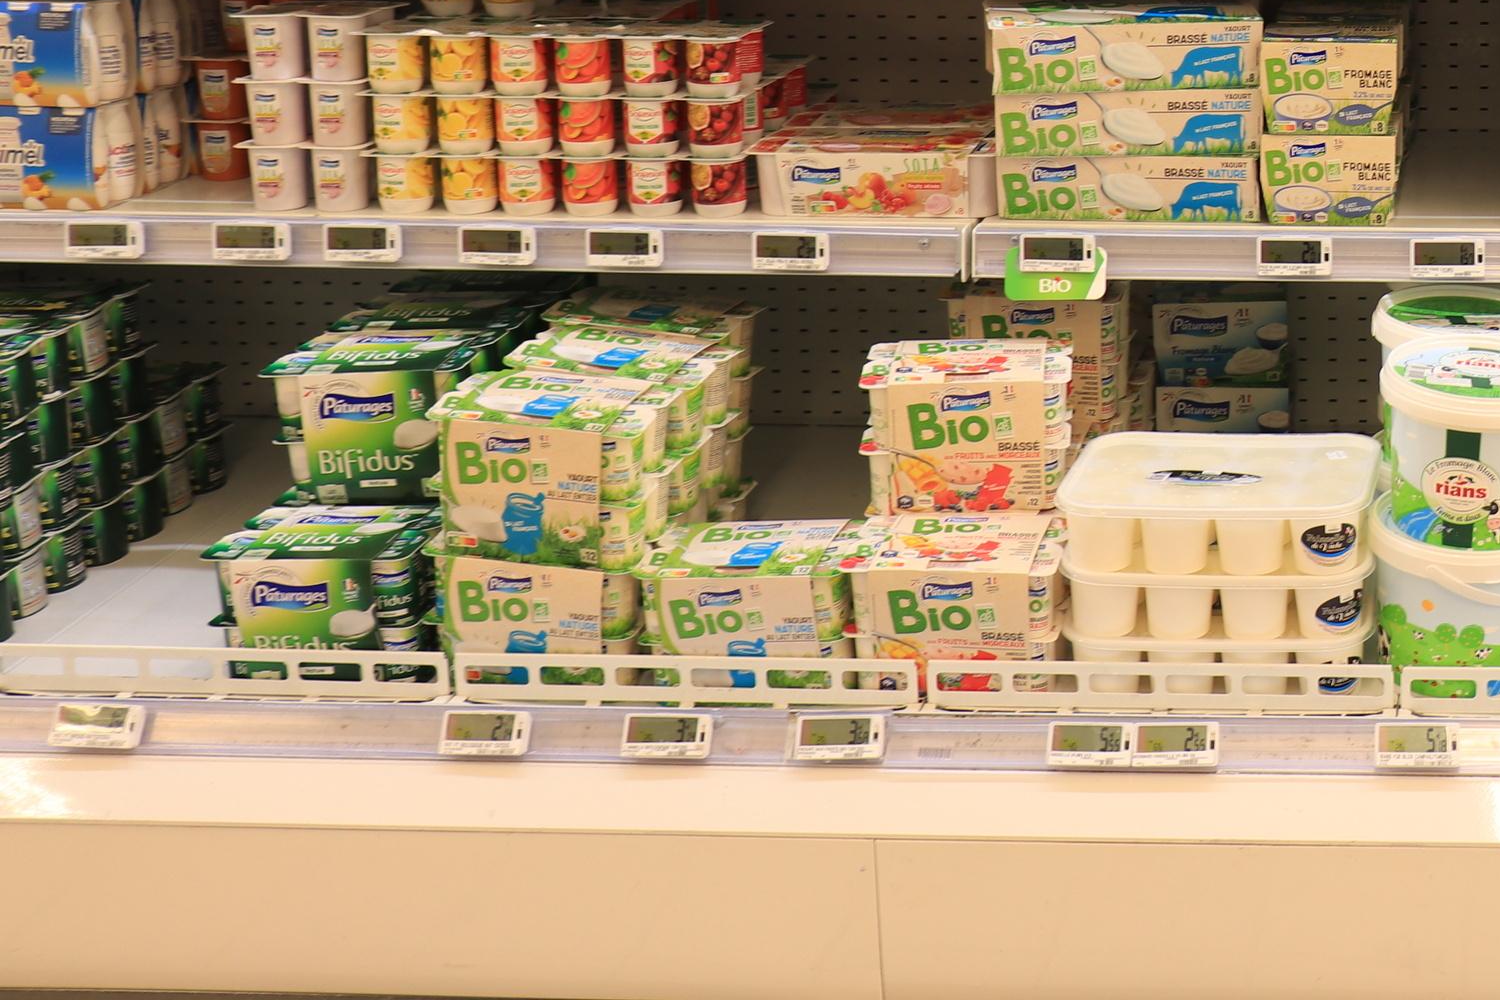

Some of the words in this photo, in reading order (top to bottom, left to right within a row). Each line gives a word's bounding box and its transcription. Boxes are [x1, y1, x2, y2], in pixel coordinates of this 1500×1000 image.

[1211, 32, 1250, 44] NATURE
[1344, 69, 1392, 79] FROMAGE
[1359, 79, 1392, 89] BLANC
[1212, 100, 1251, 111] NATURE
[1342, 162, 1391, 172] FROMAGE
[1208, 168, 1246, 179] NATURE
[1358, 172, 1391, 182] BLANC
[326, 349, 421, 363] Bifidus
[318, 449, 419, 478] Bifidus
[1435, 481, 1487, 498] rians
[265, 532, 364, 546] Bifidus
